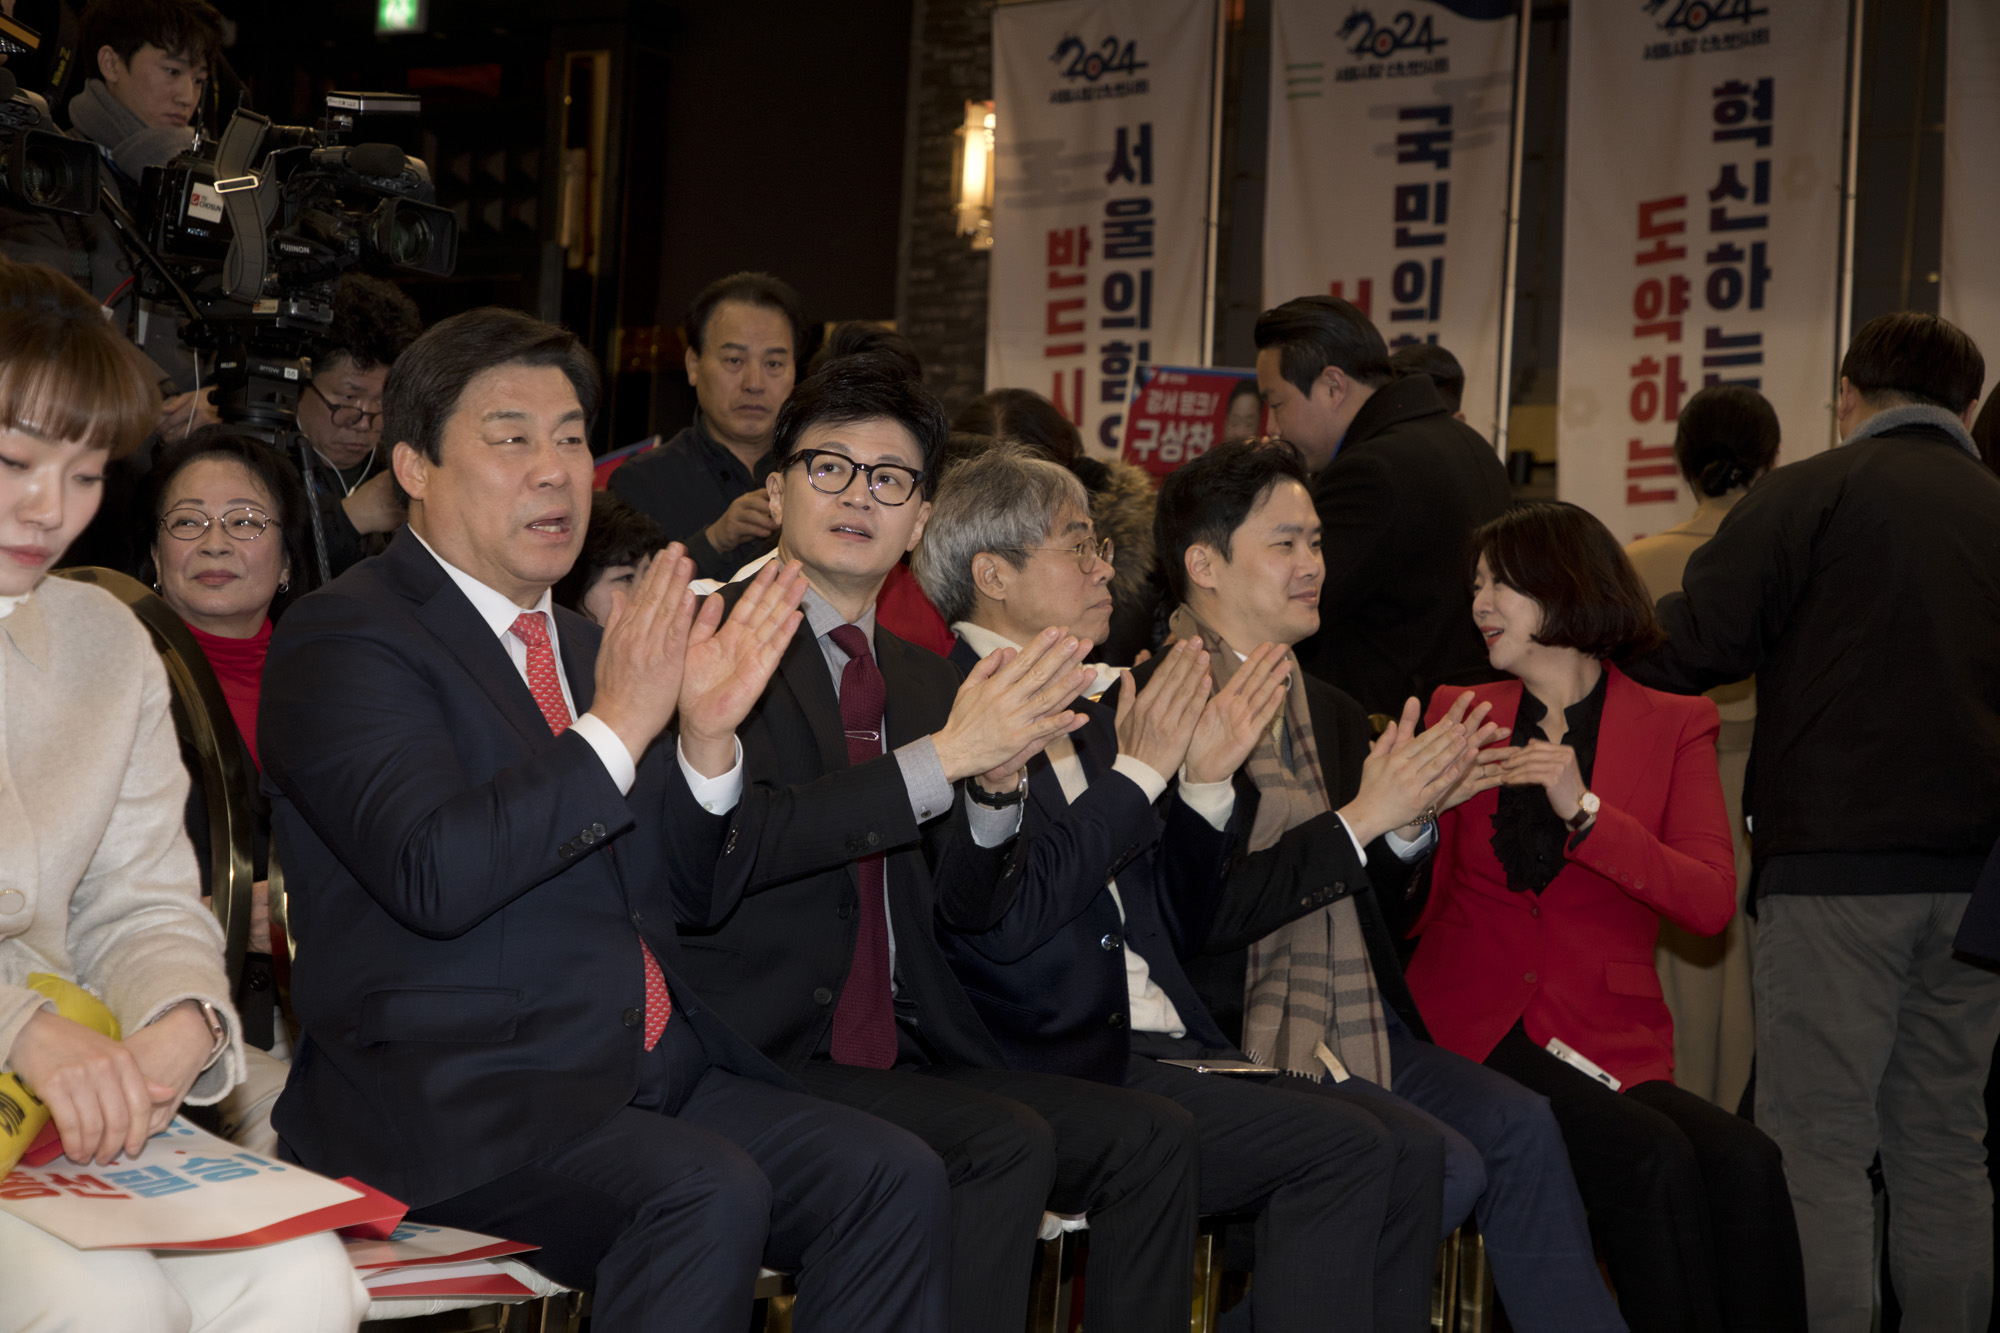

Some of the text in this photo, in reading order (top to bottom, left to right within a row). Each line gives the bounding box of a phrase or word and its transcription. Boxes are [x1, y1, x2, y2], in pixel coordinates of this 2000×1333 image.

[1336, 9, 1446, 57] 2024
[1050, 36, 1148, 81] 2024
[199, 202, 222, 212] CHOSUN
[280, 242, 310, 254] FUJINON
[1702, 77, 1774, 390] 혁신하는
[1045, 225, 1091, 428] 반드시
[259, 364, 280, 374] arrow
[1625, 195, 1691, 505] 도약하는
[1131, 418, 1215, 464] 구상찬
[101, 1153, 287, 1198] 필승!
